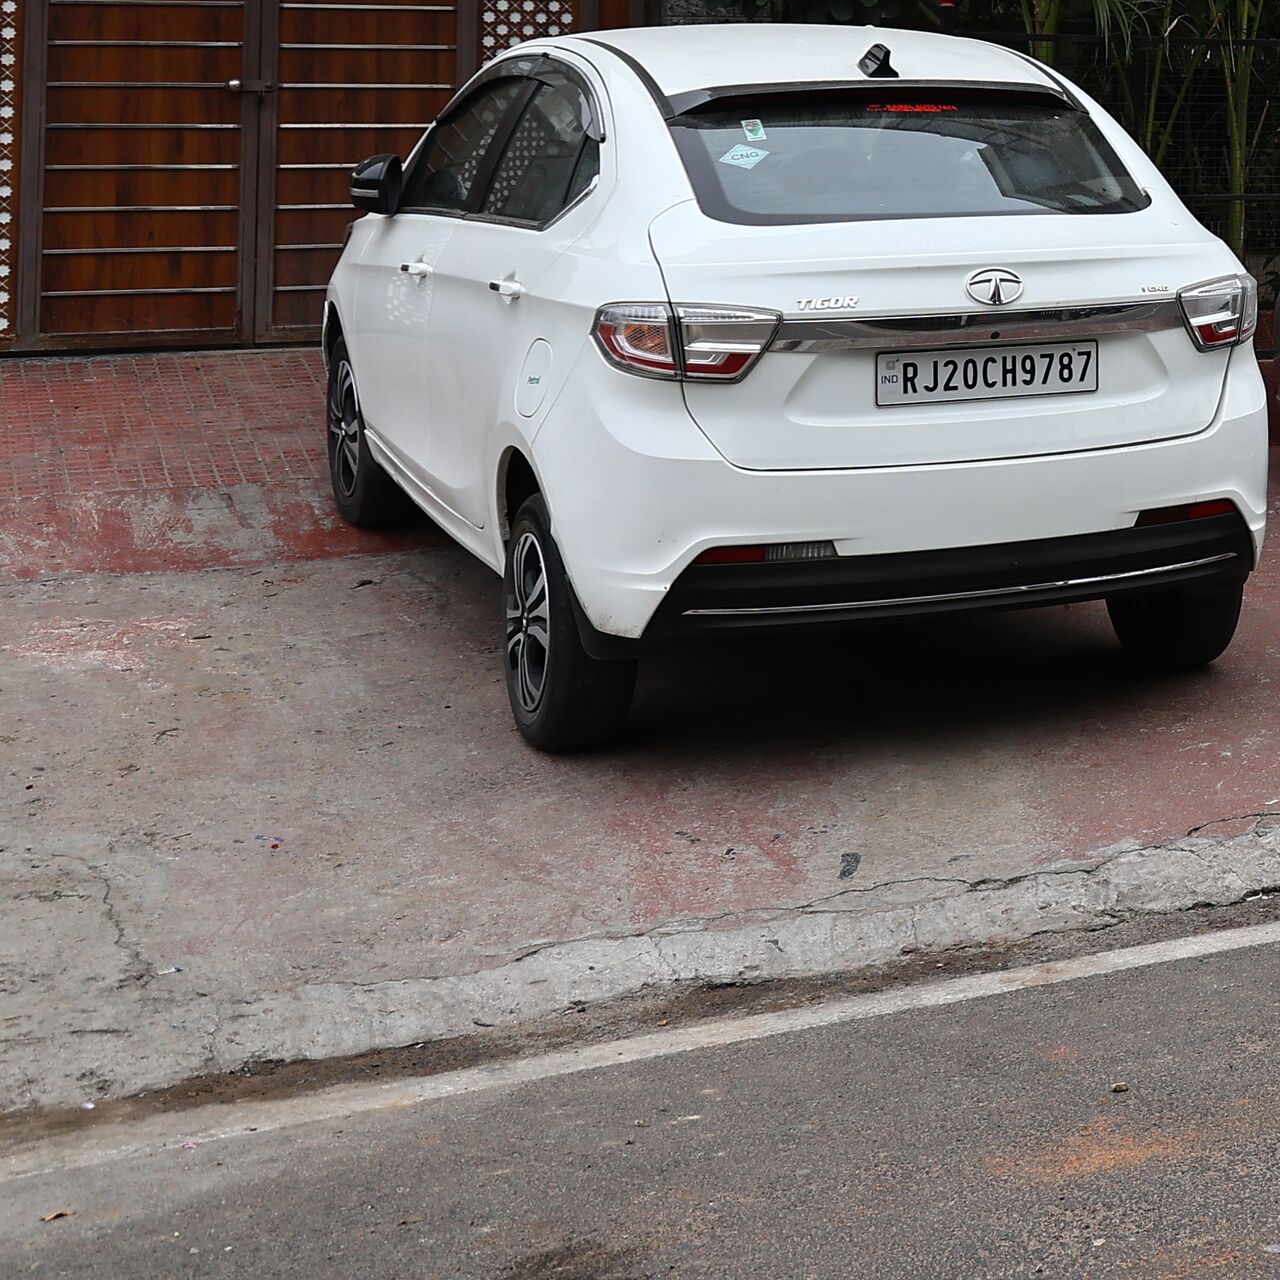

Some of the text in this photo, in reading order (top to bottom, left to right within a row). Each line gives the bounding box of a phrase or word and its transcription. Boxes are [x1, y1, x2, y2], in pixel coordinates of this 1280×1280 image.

[731, 151, 761, 161] CNG
[797, 296, 861, 311] TIGOR
[881, 350, 1093, 395] IND RJ20CH9787
